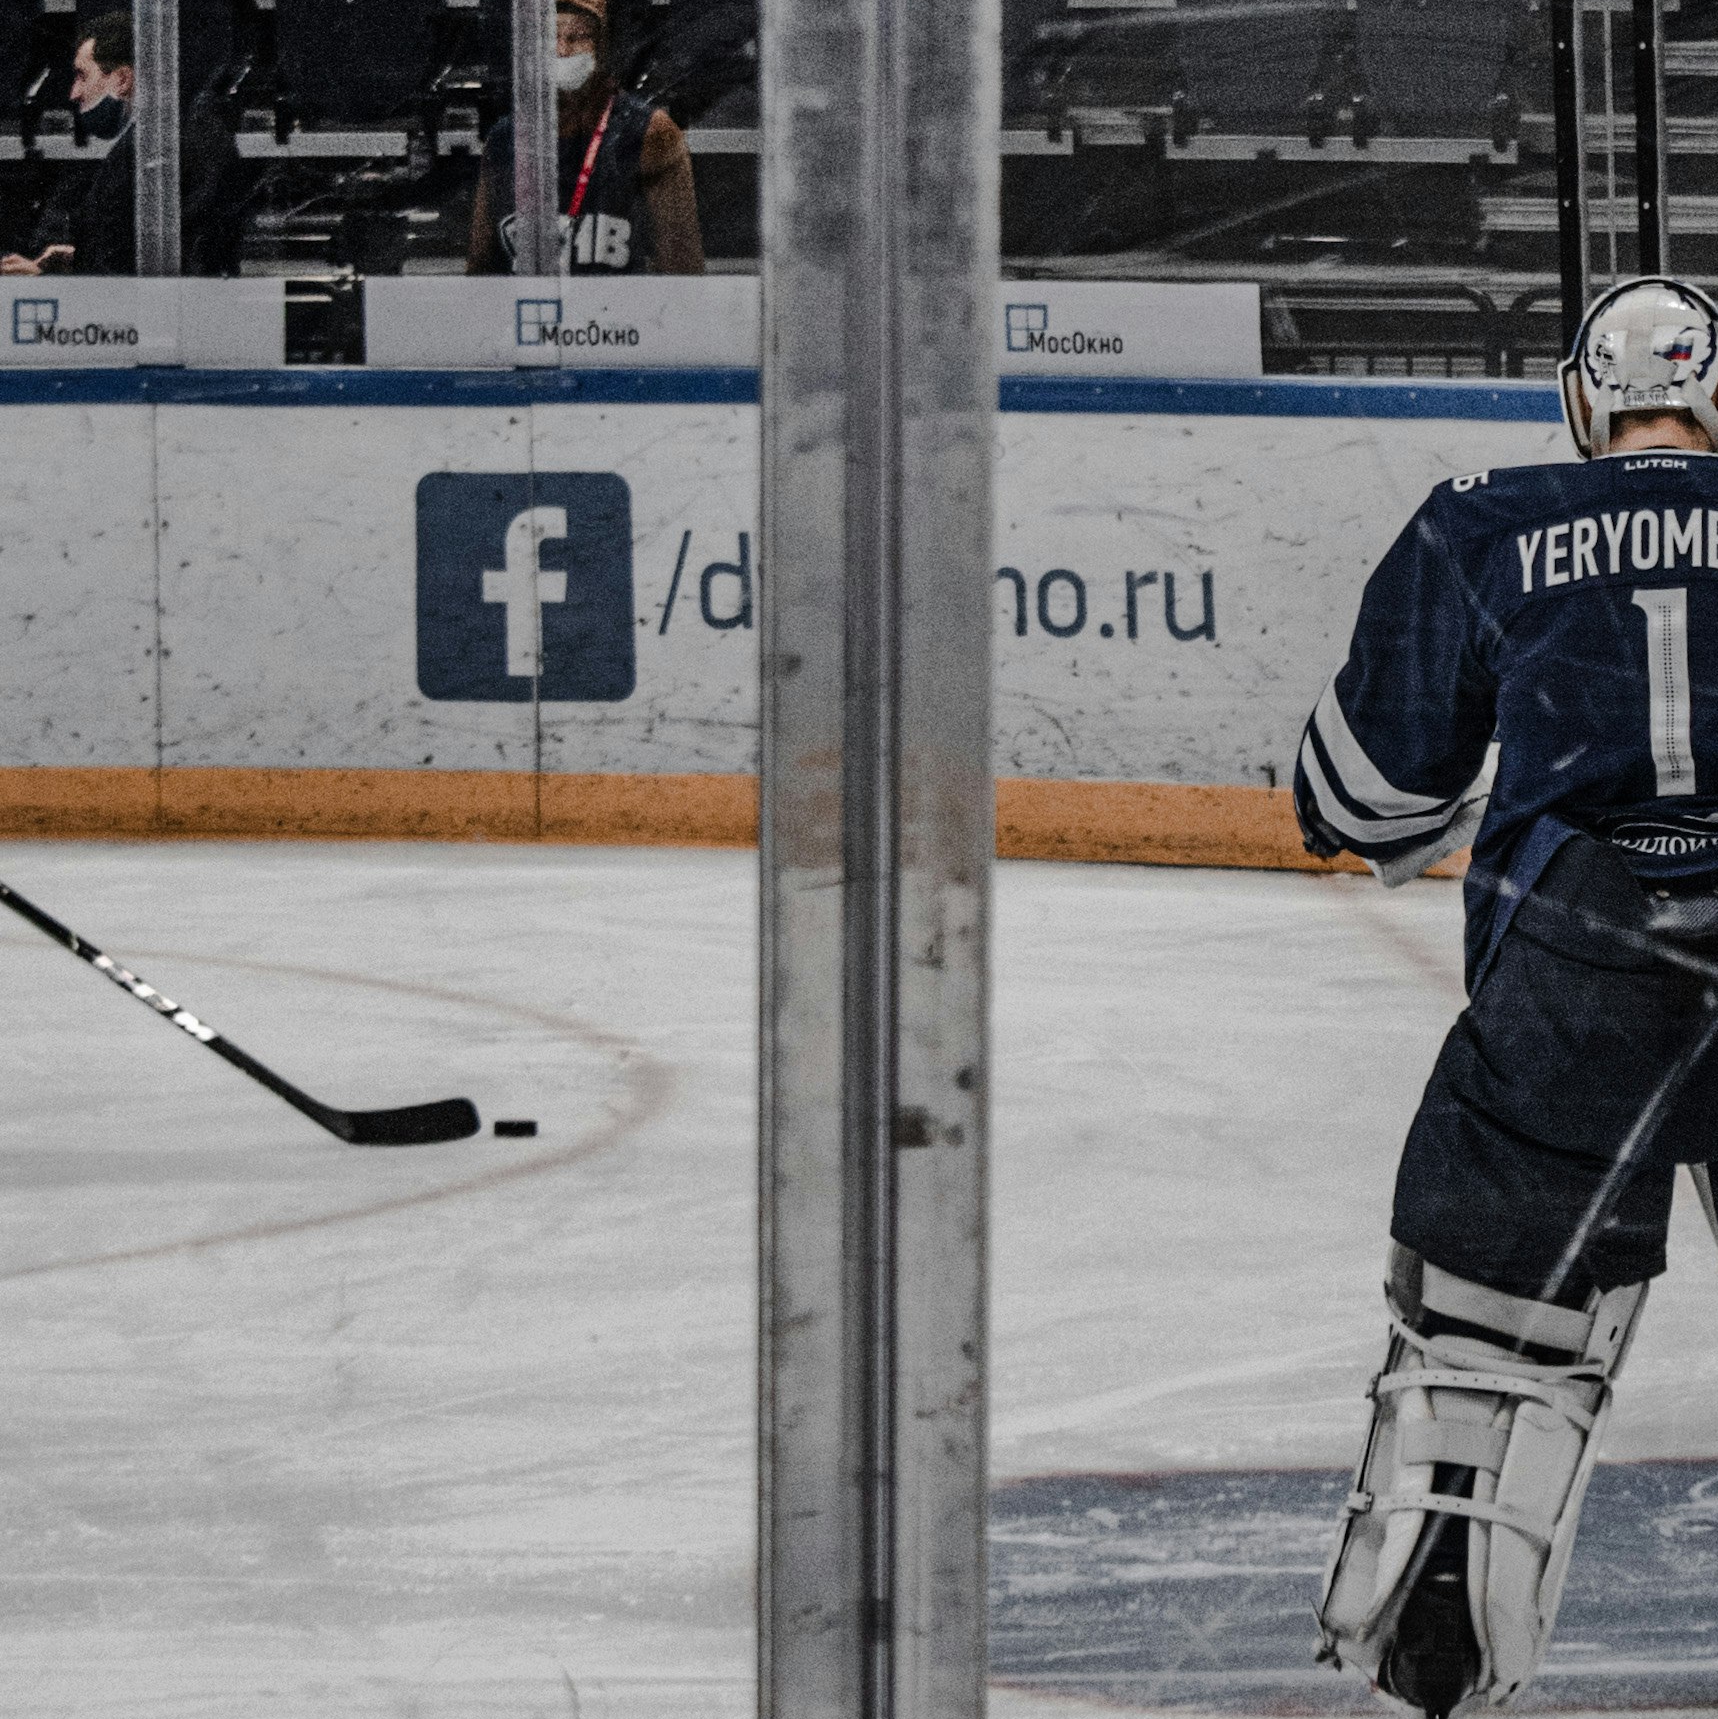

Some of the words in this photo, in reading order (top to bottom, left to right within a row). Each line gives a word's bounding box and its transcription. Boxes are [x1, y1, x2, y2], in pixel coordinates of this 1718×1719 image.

[1029, 330, 1124, 356] МосОкно
[1623, 458, 1688, 472] LUTCH
[1632, 587, 1697, 797] 1
